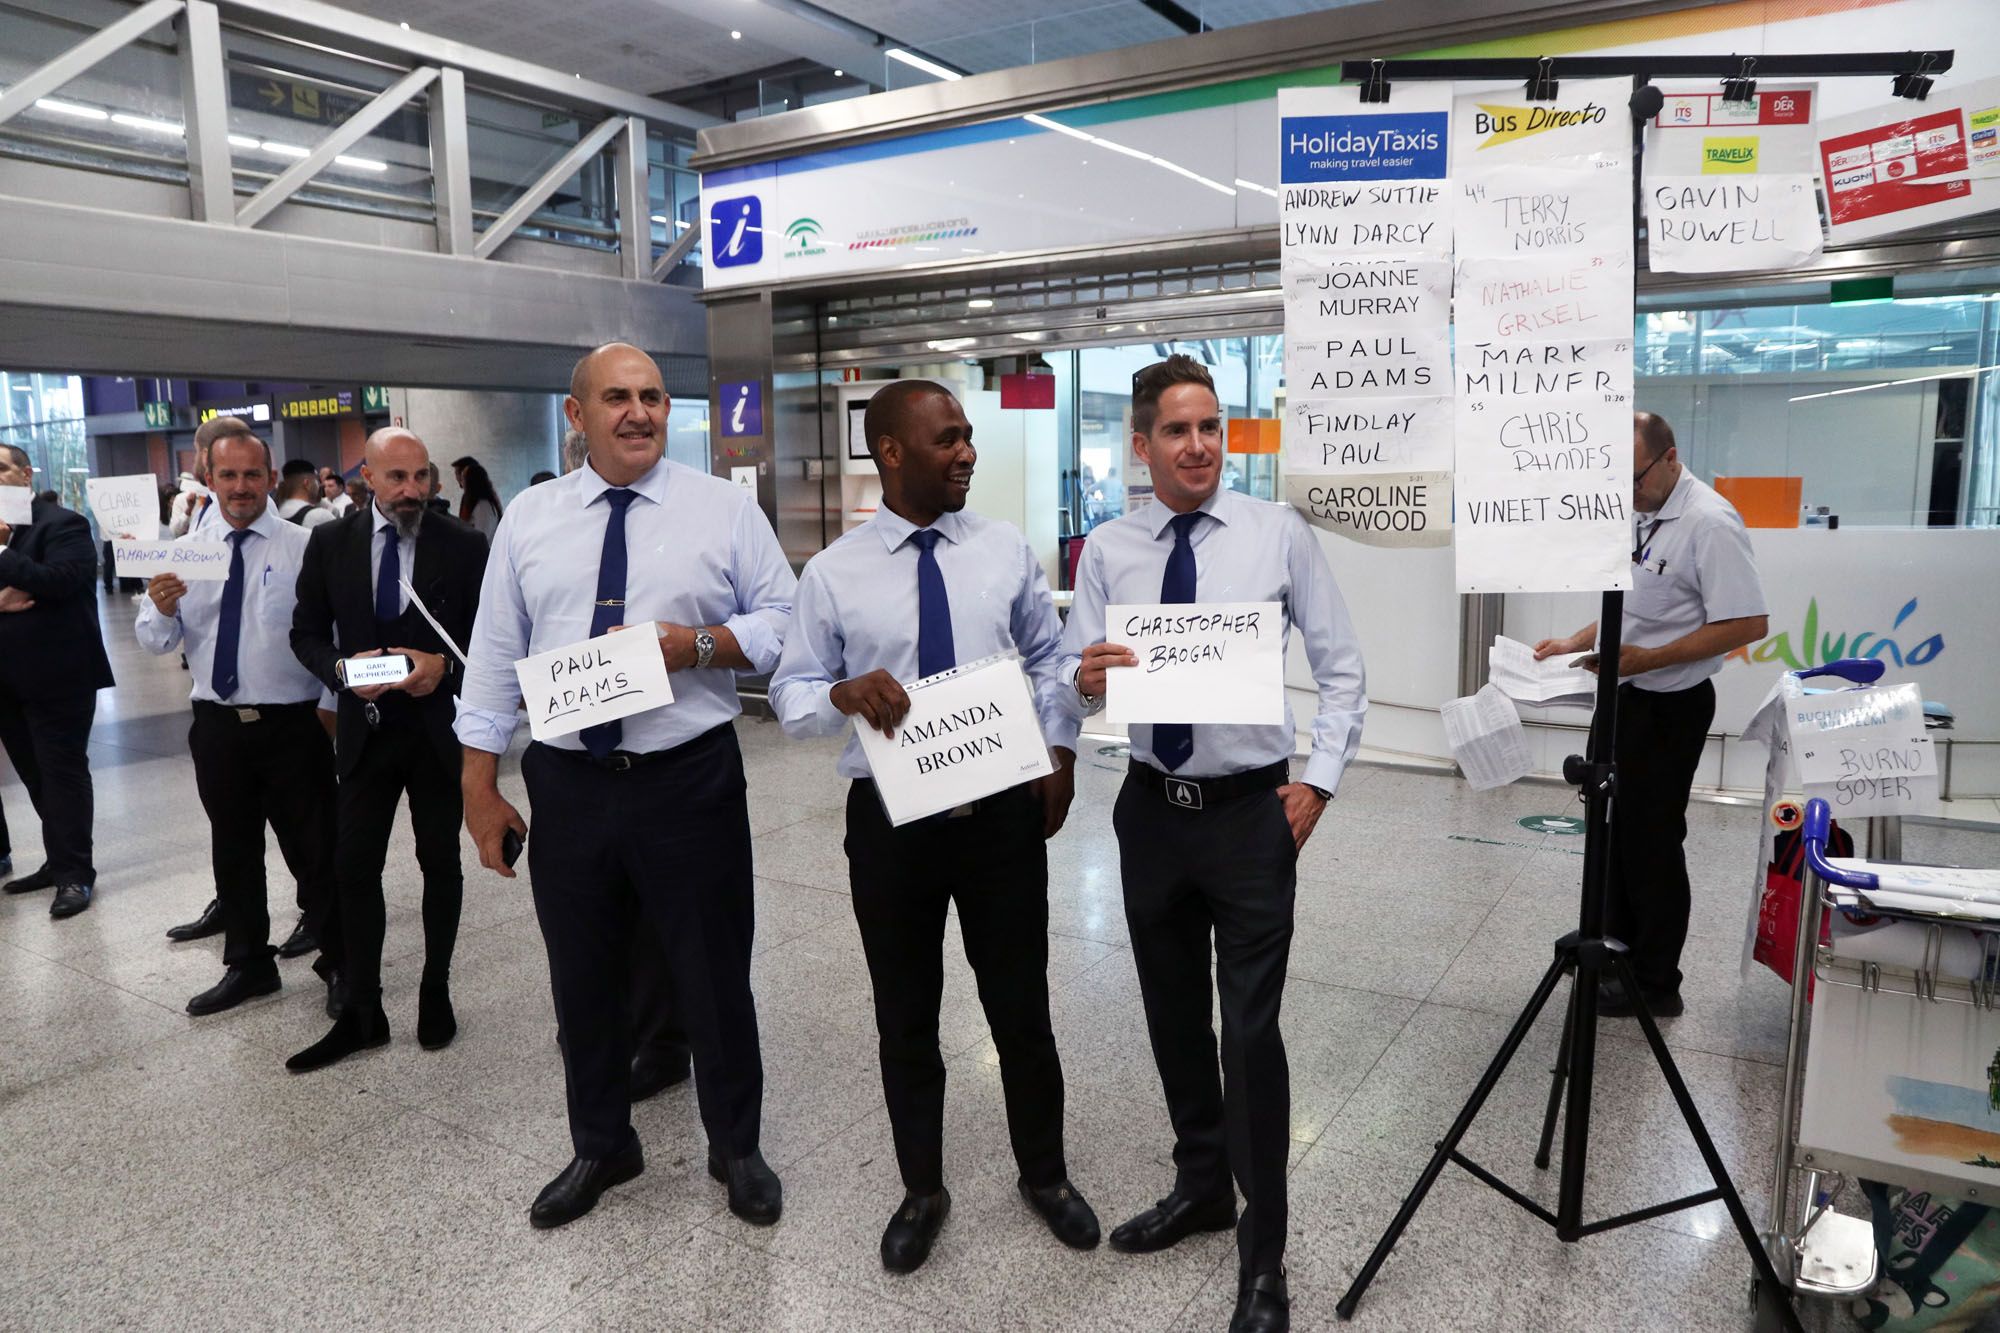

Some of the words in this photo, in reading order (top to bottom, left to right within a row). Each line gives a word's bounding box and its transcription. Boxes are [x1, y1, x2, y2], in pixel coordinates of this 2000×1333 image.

[1475, 113, 1517, 135] Bus
[1526, 102, 1606, 131] Directo
[1773, 99, 1795, 112] DER
[1290, 129, 1439, 158] HolidayTaxis
[1310, 158, 1349, 171] making
[1351, 157, 1381, 168] travel
[1383, 157, 1414, 167] easier
[1285, 187, 1361, 212] ANDREW
[1492, 194, 1569, 228] TERRY
[1656, 185, 1759, 211] GAVIN
[1285, 223, 1339, 247] LYNN
[1353, 222, 1434, 245] DARCY
[1660, 218, 1785, 245] ROWELL
[1318, 269, 1419, 290] JOANNE
[1482, 268, 1590, 306] NATHALIE
[1319, 296, 1420, 316] MURRAY
[1497, 302, 1599, 337] GRISEL
[1326, 337, 1417, 359] PAUL
[1482, 344, 1586, 368] MARK
[1310, 366, 1431, 390] ADAMS
[1307, 412, 1416, 435] FINDLAY
[1323, 442, 1389, 465] PAUL
[1307, 486, 1427, 508] CAROLINE
[1467, 497, 1551, 525] VINEET
[1557, 493, 1625, 521] SHAH
[116, 547, 168, 562] AMANDA
[172, 547, 226, 563] BROWN
[1125, 612, 1260, 639] CHRISTOPHER
[550, 649, 612, 683] PAUL
[1146, 639, 1227, 674] BROGAN
[547, 672, 629, 714] ADAMS
[900, 701, 1003, 748] AMANDA
[915, 732, 1004, 775] BROWN
